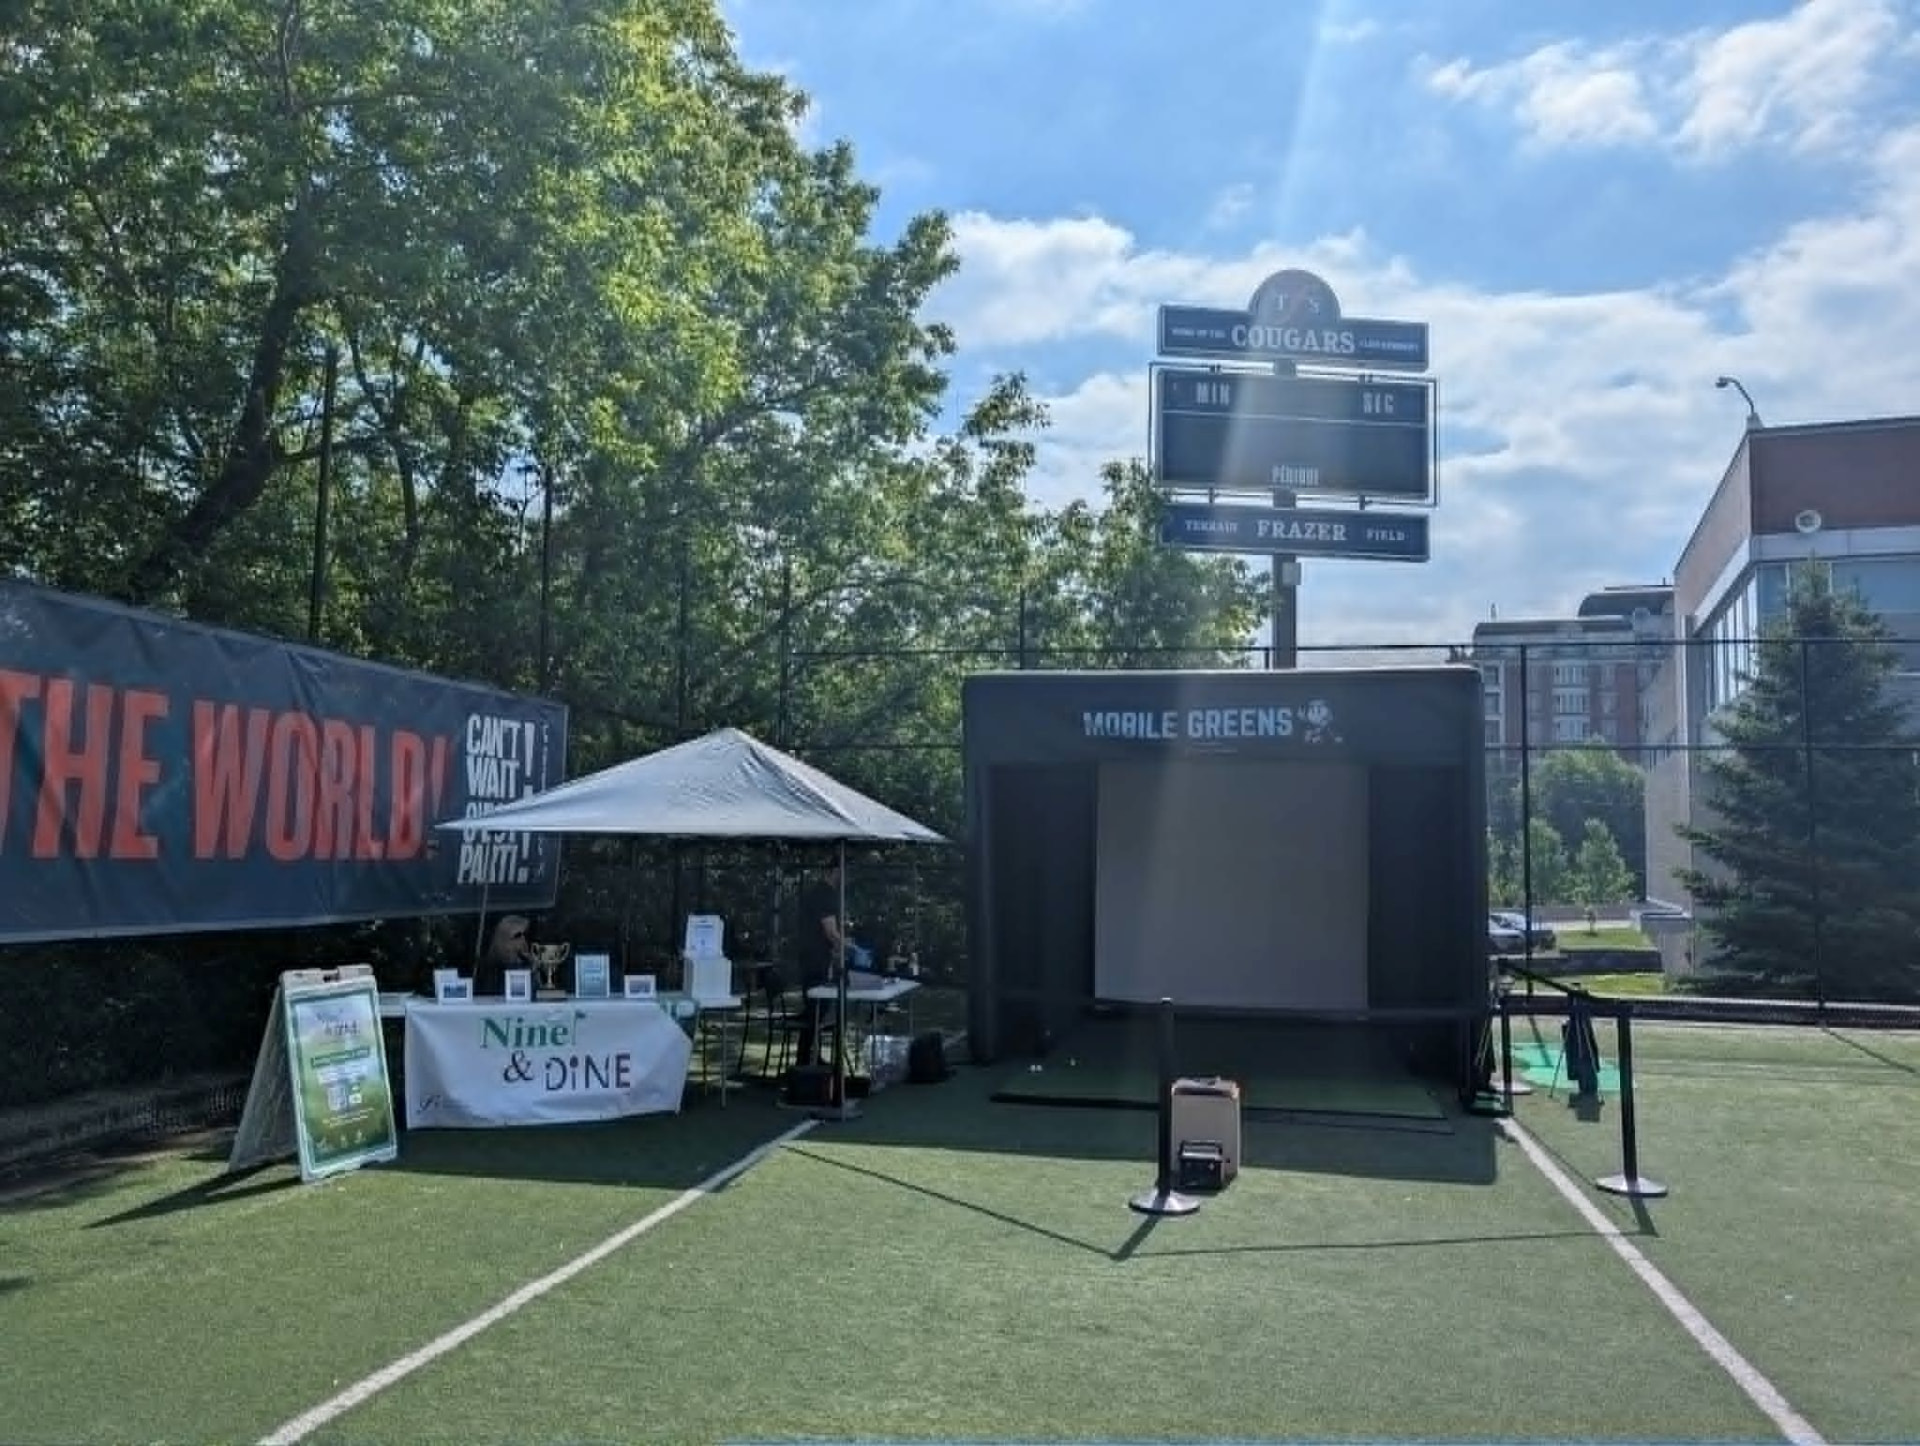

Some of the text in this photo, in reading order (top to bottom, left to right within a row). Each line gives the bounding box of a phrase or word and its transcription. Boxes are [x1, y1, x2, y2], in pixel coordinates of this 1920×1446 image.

[1231, 324, 1355, 354] COUGARS
[1256, 519, 1348, 542] FRAZER
[466, 713, 522, 759] CAN'T
[1083, 707, 1293, 739] MOBILE GREENS
[0, 670, 169, 859] THE
[193, 698, 455, 862] WORLD!
[480, 1017, 568, 1049] Nine
[503, 1050, 534, 1083] &
